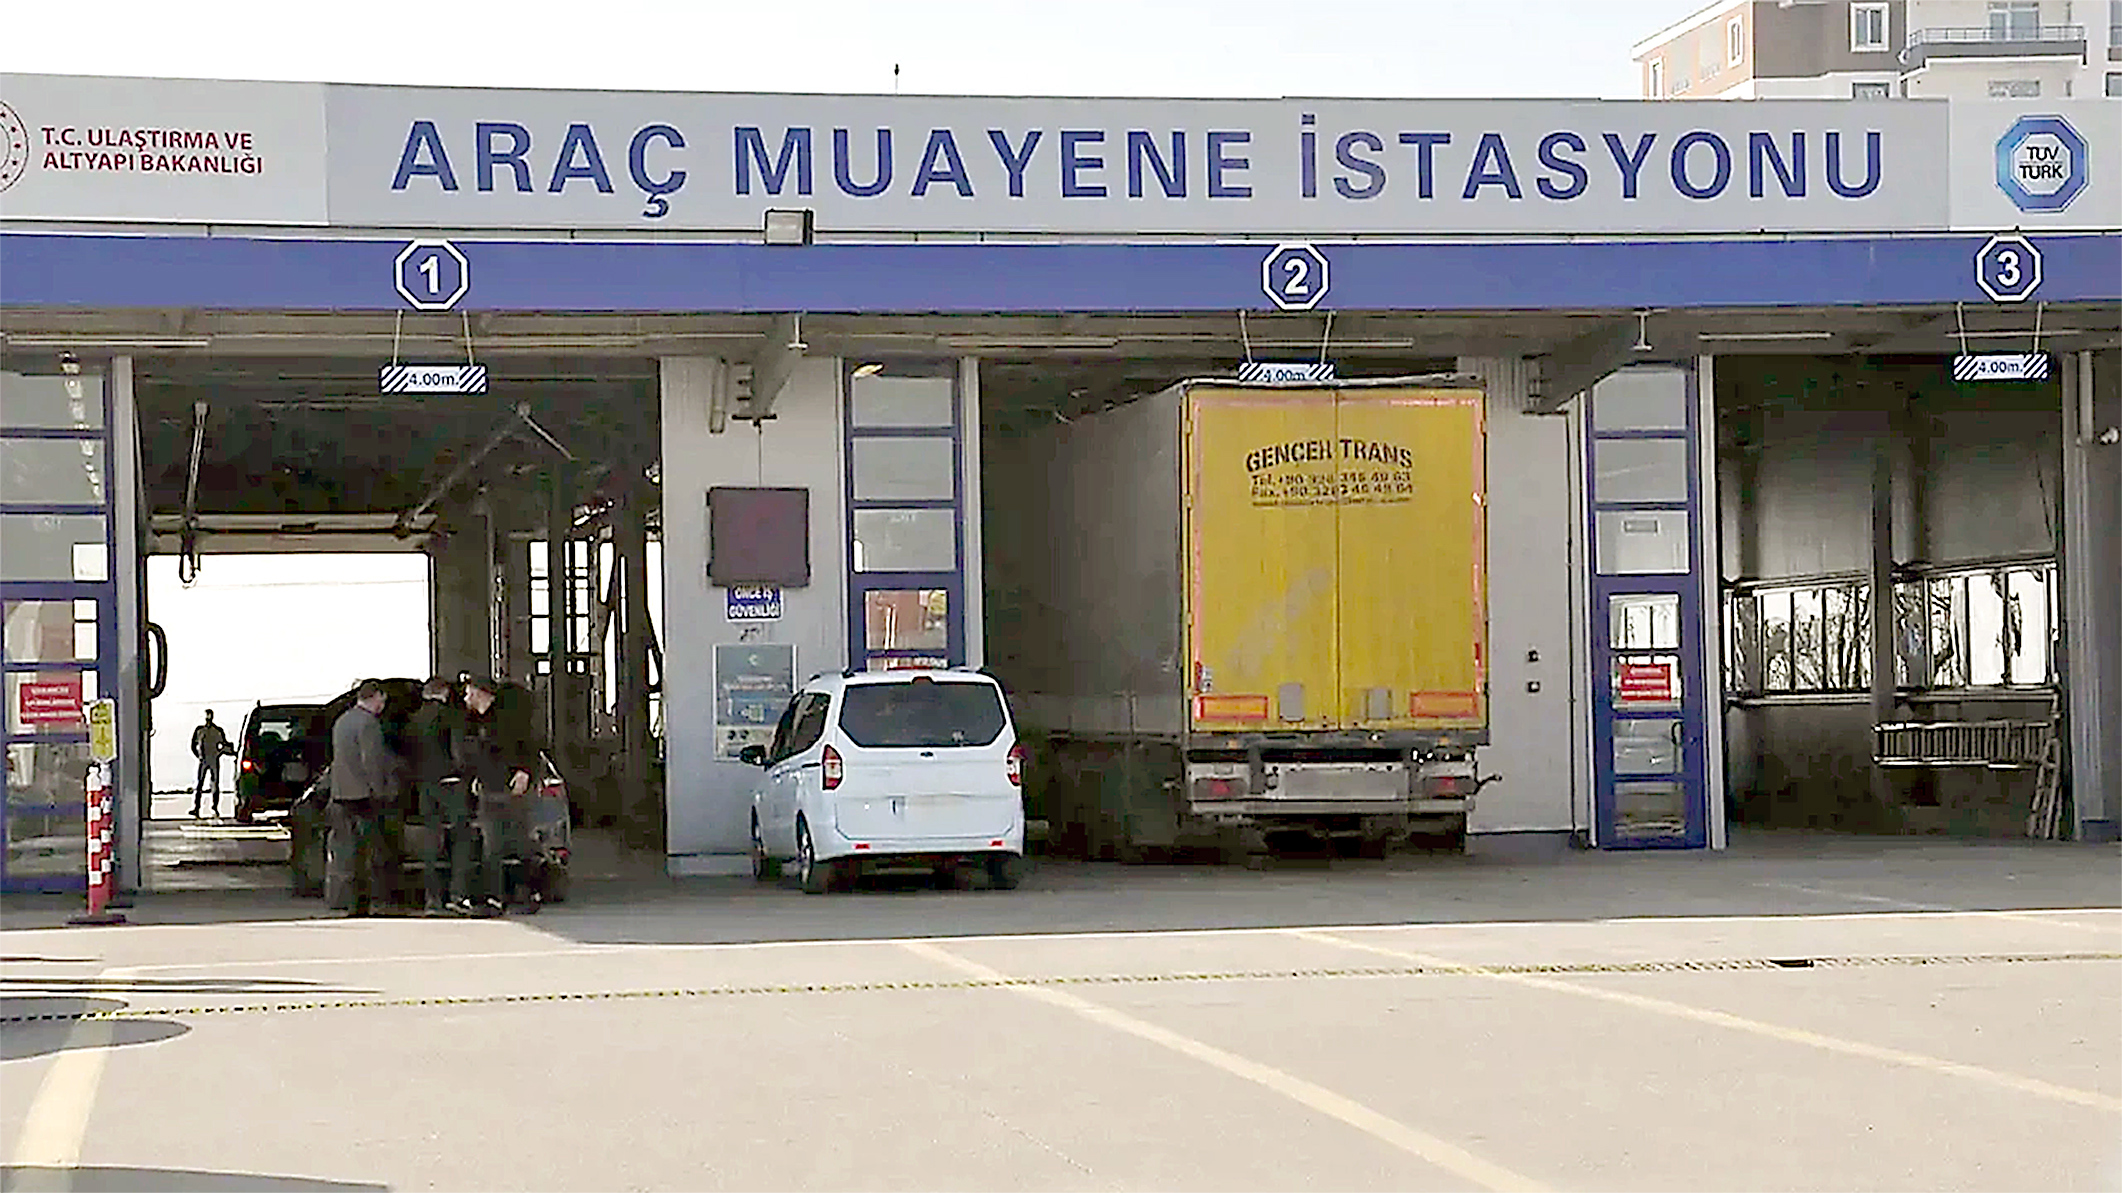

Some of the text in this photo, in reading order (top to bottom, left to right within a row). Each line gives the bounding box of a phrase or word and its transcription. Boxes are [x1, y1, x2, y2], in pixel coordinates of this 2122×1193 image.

[42, 128, 252, 152] T.C. ULAŞTIRMA VE
[43, 153, 263, 174] ALTYAPI BAKANLIĞI
[391, 114, 1882, 216] ARAÇ MUAYENE İSTASYONU
[419, 256, 439, 293] 1
[1284, 258, 1309, 294] 2
[1996, 250, 2021, 286] 3
[1339, 439, 1413, 468] TRANS
